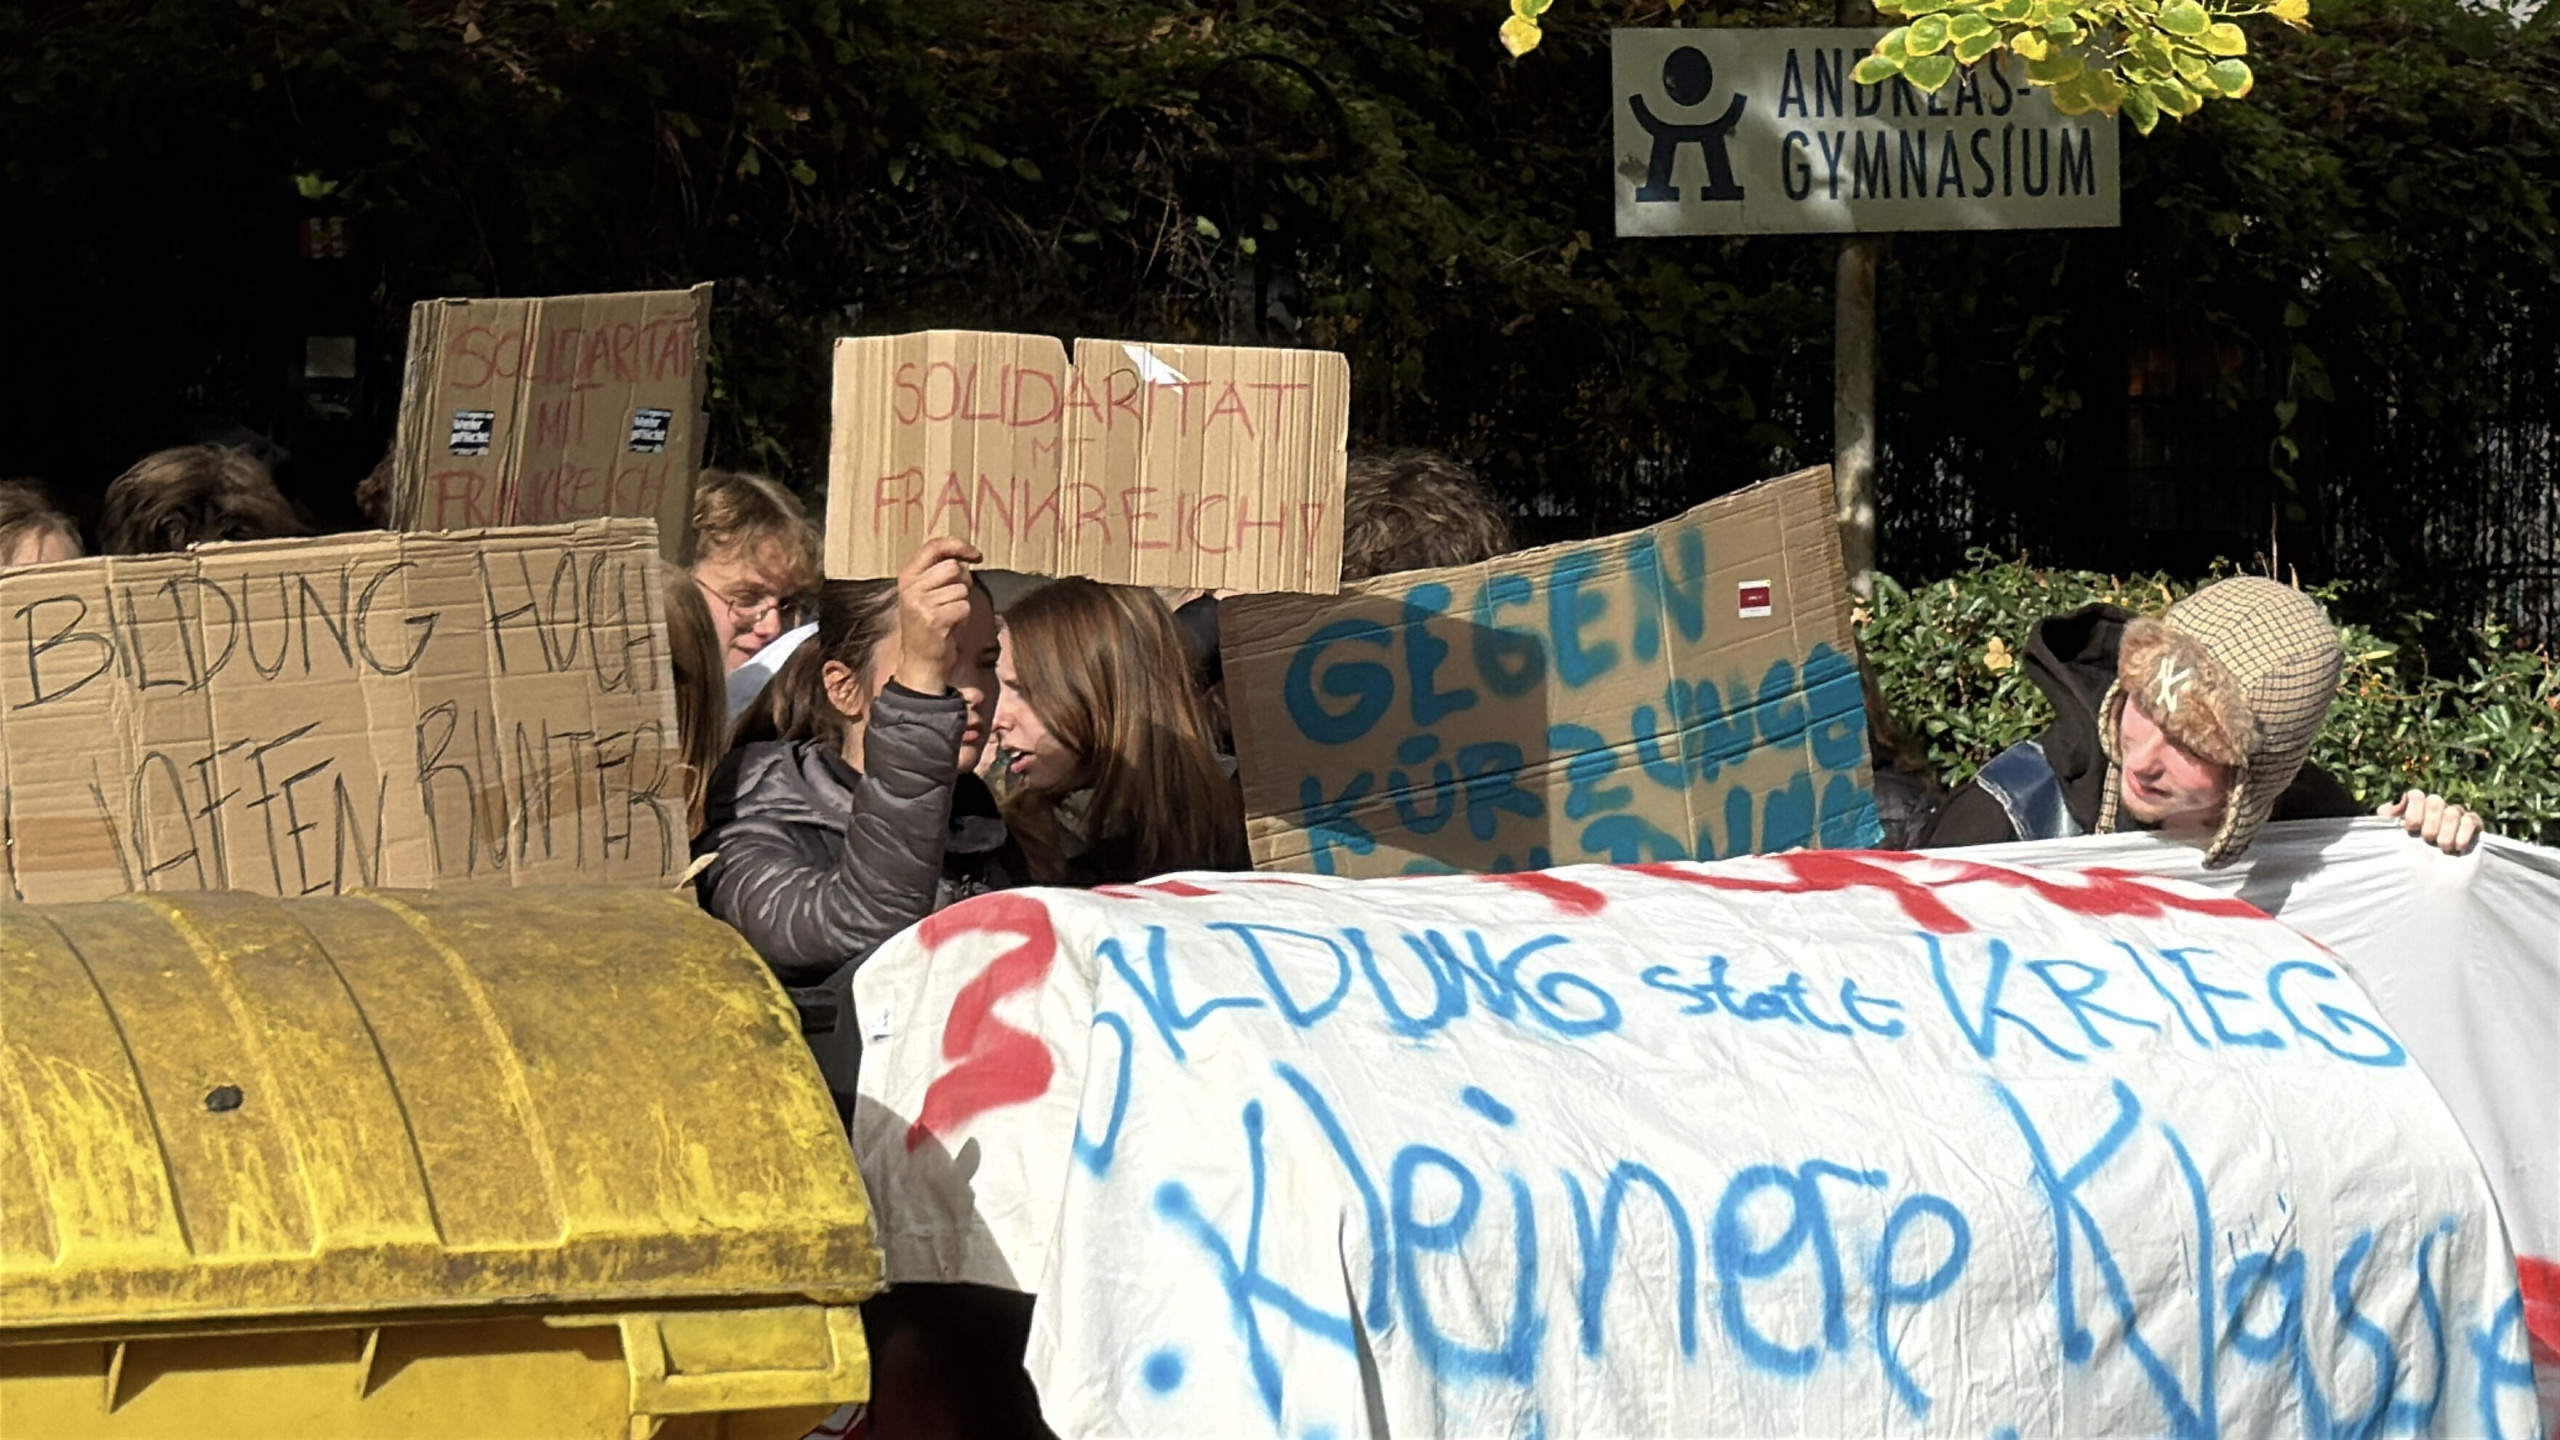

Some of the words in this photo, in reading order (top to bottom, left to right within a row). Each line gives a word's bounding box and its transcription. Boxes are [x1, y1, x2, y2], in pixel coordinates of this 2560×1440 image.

[1782, 127, 2097, 201] GYMNASIUM
[14, 561, 440, 710] BILDUNG
[478, 550, 657, 695] HOCH
[1285, 526, 1708, 745] GEGEN
[416, 700, 673, 878] RUNTER
[1640, 954, 1905, 1039] statt
[1915, 931, 2407, 1067] KRIEG
[1152, 1062, 1972, 1430] Kleinere
